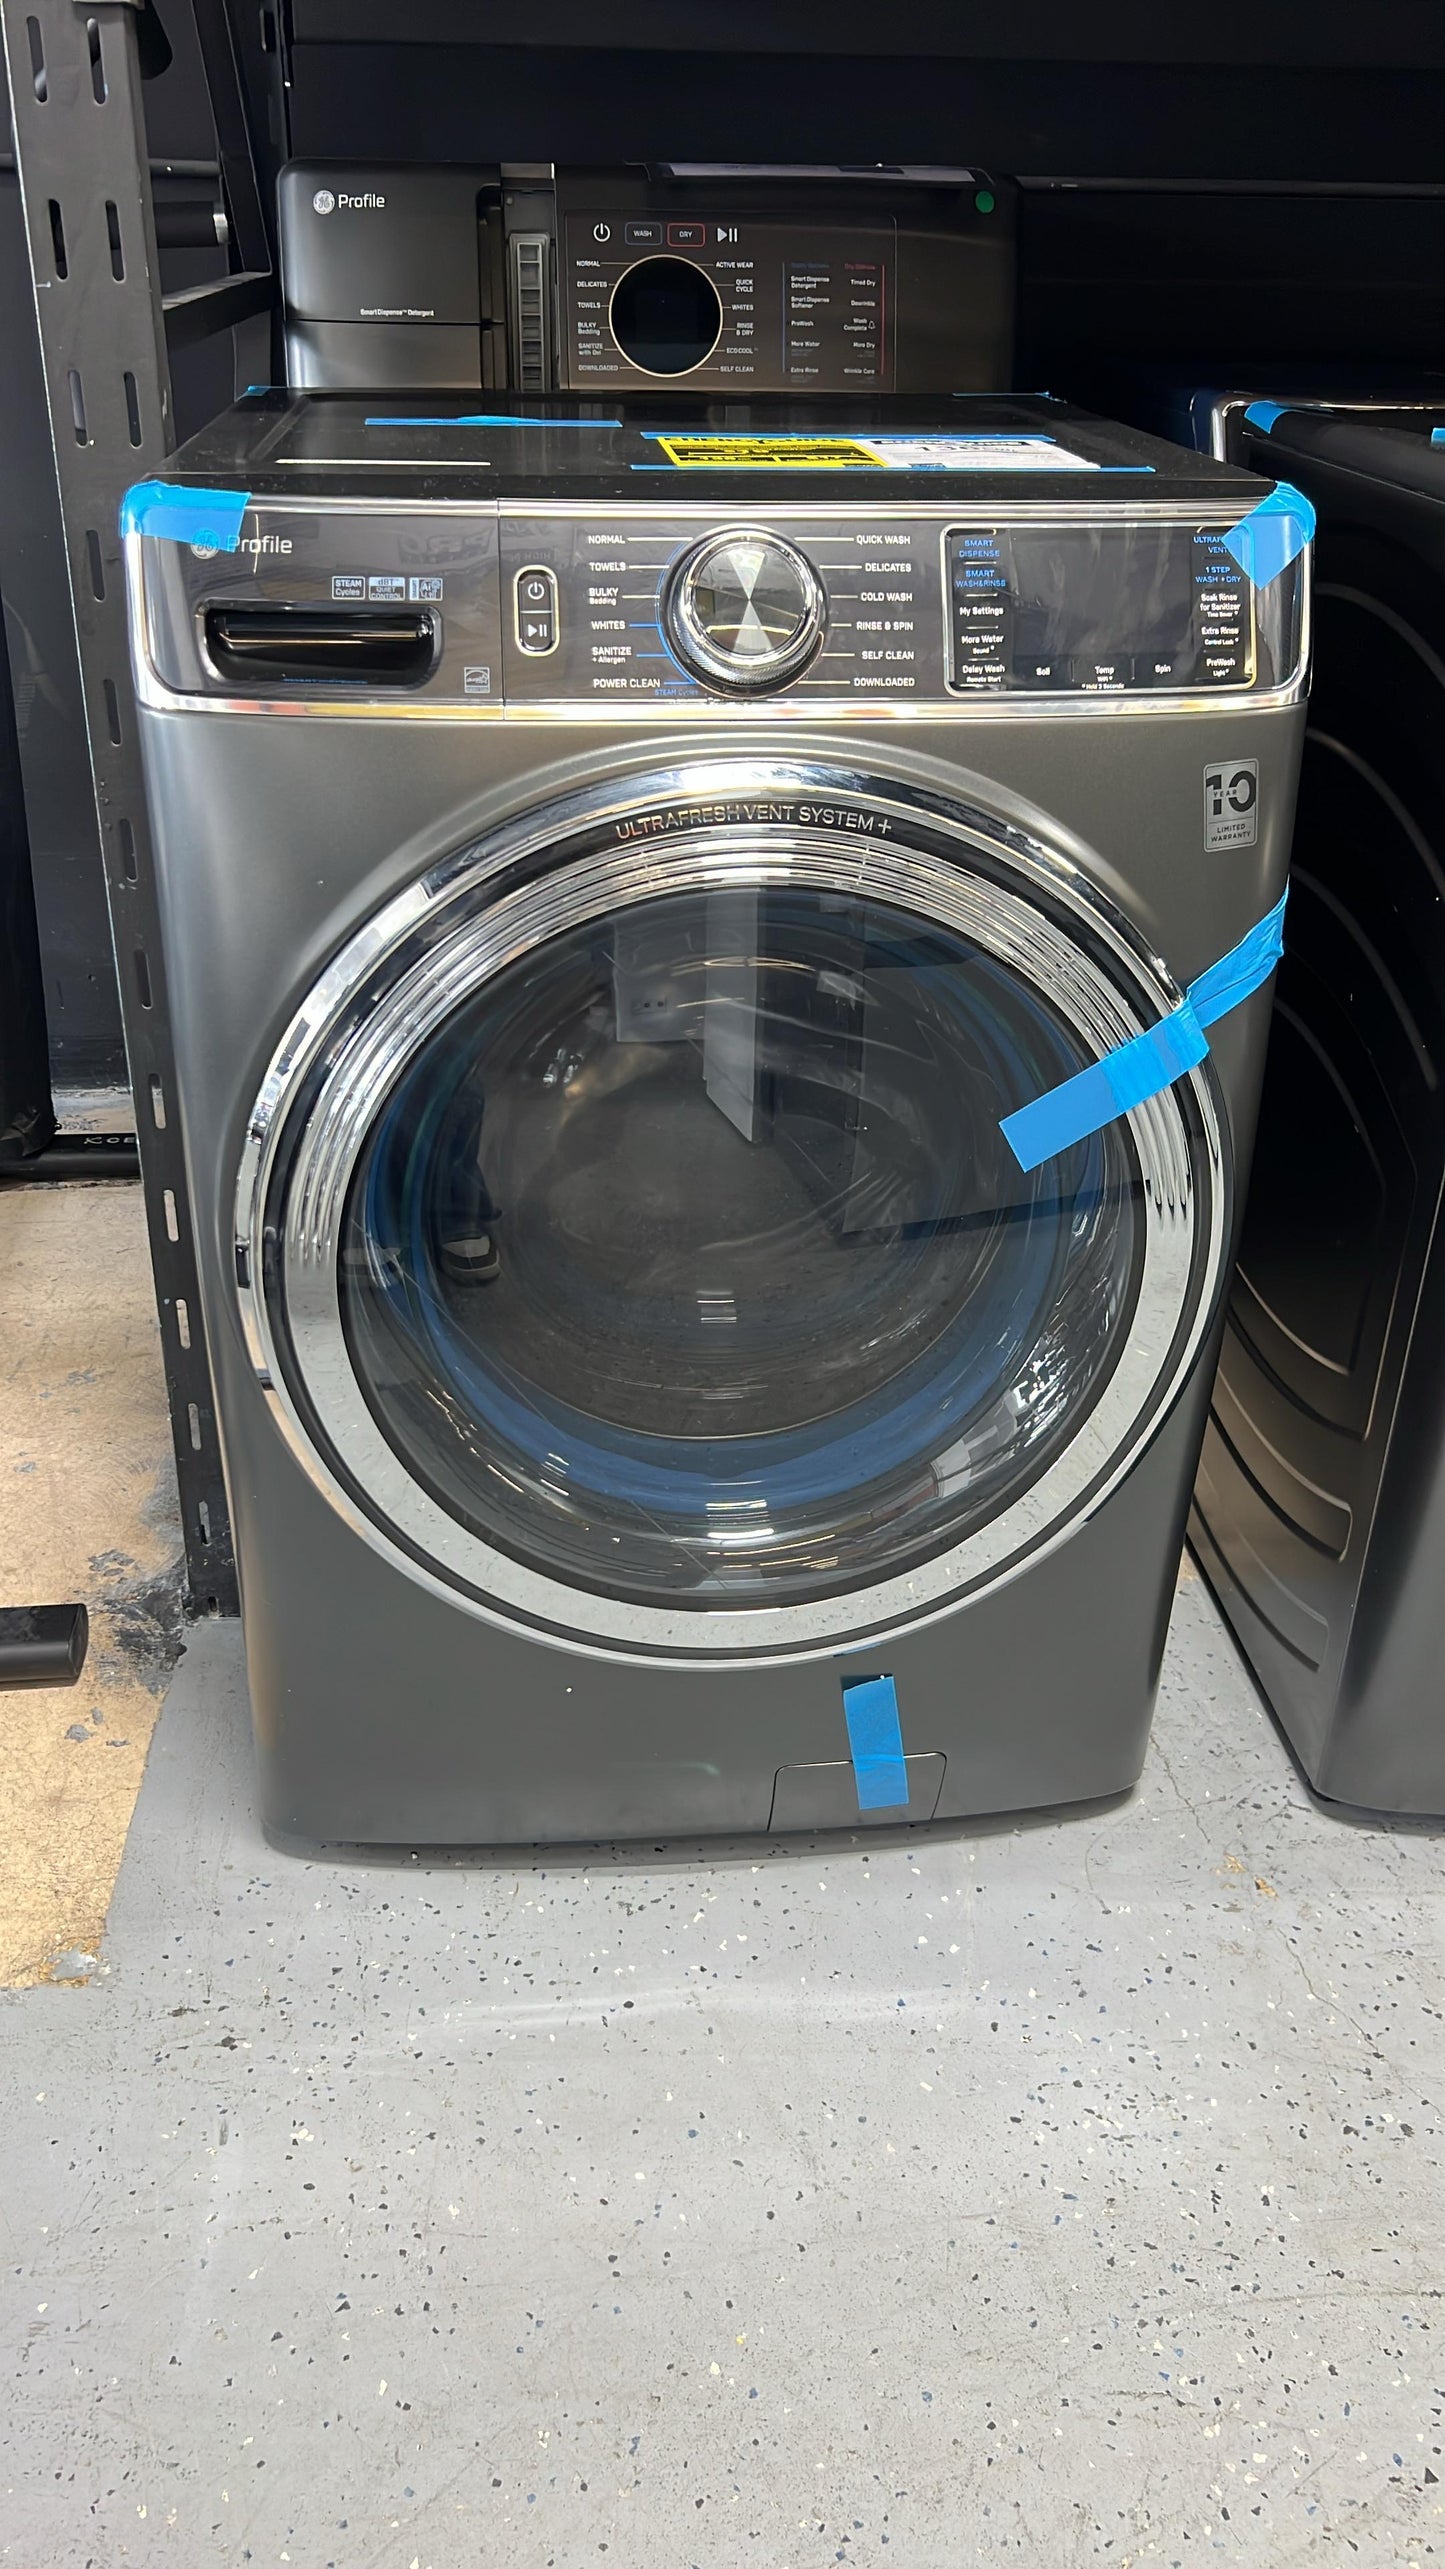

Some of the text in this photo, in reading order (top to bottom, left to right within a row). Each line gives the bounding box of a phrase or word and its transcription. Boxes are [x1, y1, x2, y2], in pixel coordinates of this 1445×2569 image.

[338, 193, 385, 208] Profile
[866, 279, 876, 287] Dry
[360, 308, 378, 316] Smart
[226, 535, 292, 553] Profile
[588, 535, 625, 544] NORMAL
[856, 535, 910, 545] QUICK WASH
[959, 550, 1000, 558] DISPENSE
[589, 561, 626, 571] TOWELS
[865, 563, 912, 572] DELICATES
[335, 579, 362, 588] STEAM
[956, 579, 1006, 587] WASH&RINSE
[335, 587, 360, 597] Cycles
[588, 587, 619, 597] BULKY
[861, 592, 913, 602] COLD WASH
[1201, 593, 1238, 601] Soak Rinse
[589, 597, 617, 606] Bedding
[1200, 602, 1241, 611] for Sanitizer
[959, 606, 1004, 617] My Settings
[591, 620, 626, 630] WHITES
[856, 621, 882, 631] RINSE
[893, 621, 913, 631] SPIN
[1201, 626, 1239, 635] Extra Rinse
[961, 635, 1004, 644] More Water
[592, 646, 632, 656] SANITIZE
[861, 650, 914, 660] SELF CLEAN
[598, 656, 626, 665] Allergen
[1206, 658, 1236, 667] PreWash
[962, 664, 1005, 674] Delay Wash
[1036, 667, 1051, 676] Soil
[1094, 665, 1115, 675] Temp
[1154, 664, 1171, 674] Spin
[593, 678, 660, 688] POWER CLEAN
[854, 677, 915, 687] DOWNLOADED
[1206, 770, 1256, 816] 10
[1213, 789, 1237, 798] YEAR
[615, 804, 892, 839] ULTRAFRESH VENT SYSTEM +
[1216, 823, 1246, 834] LIMITED
[1211, 830, 1251, 842] WARRANTY
